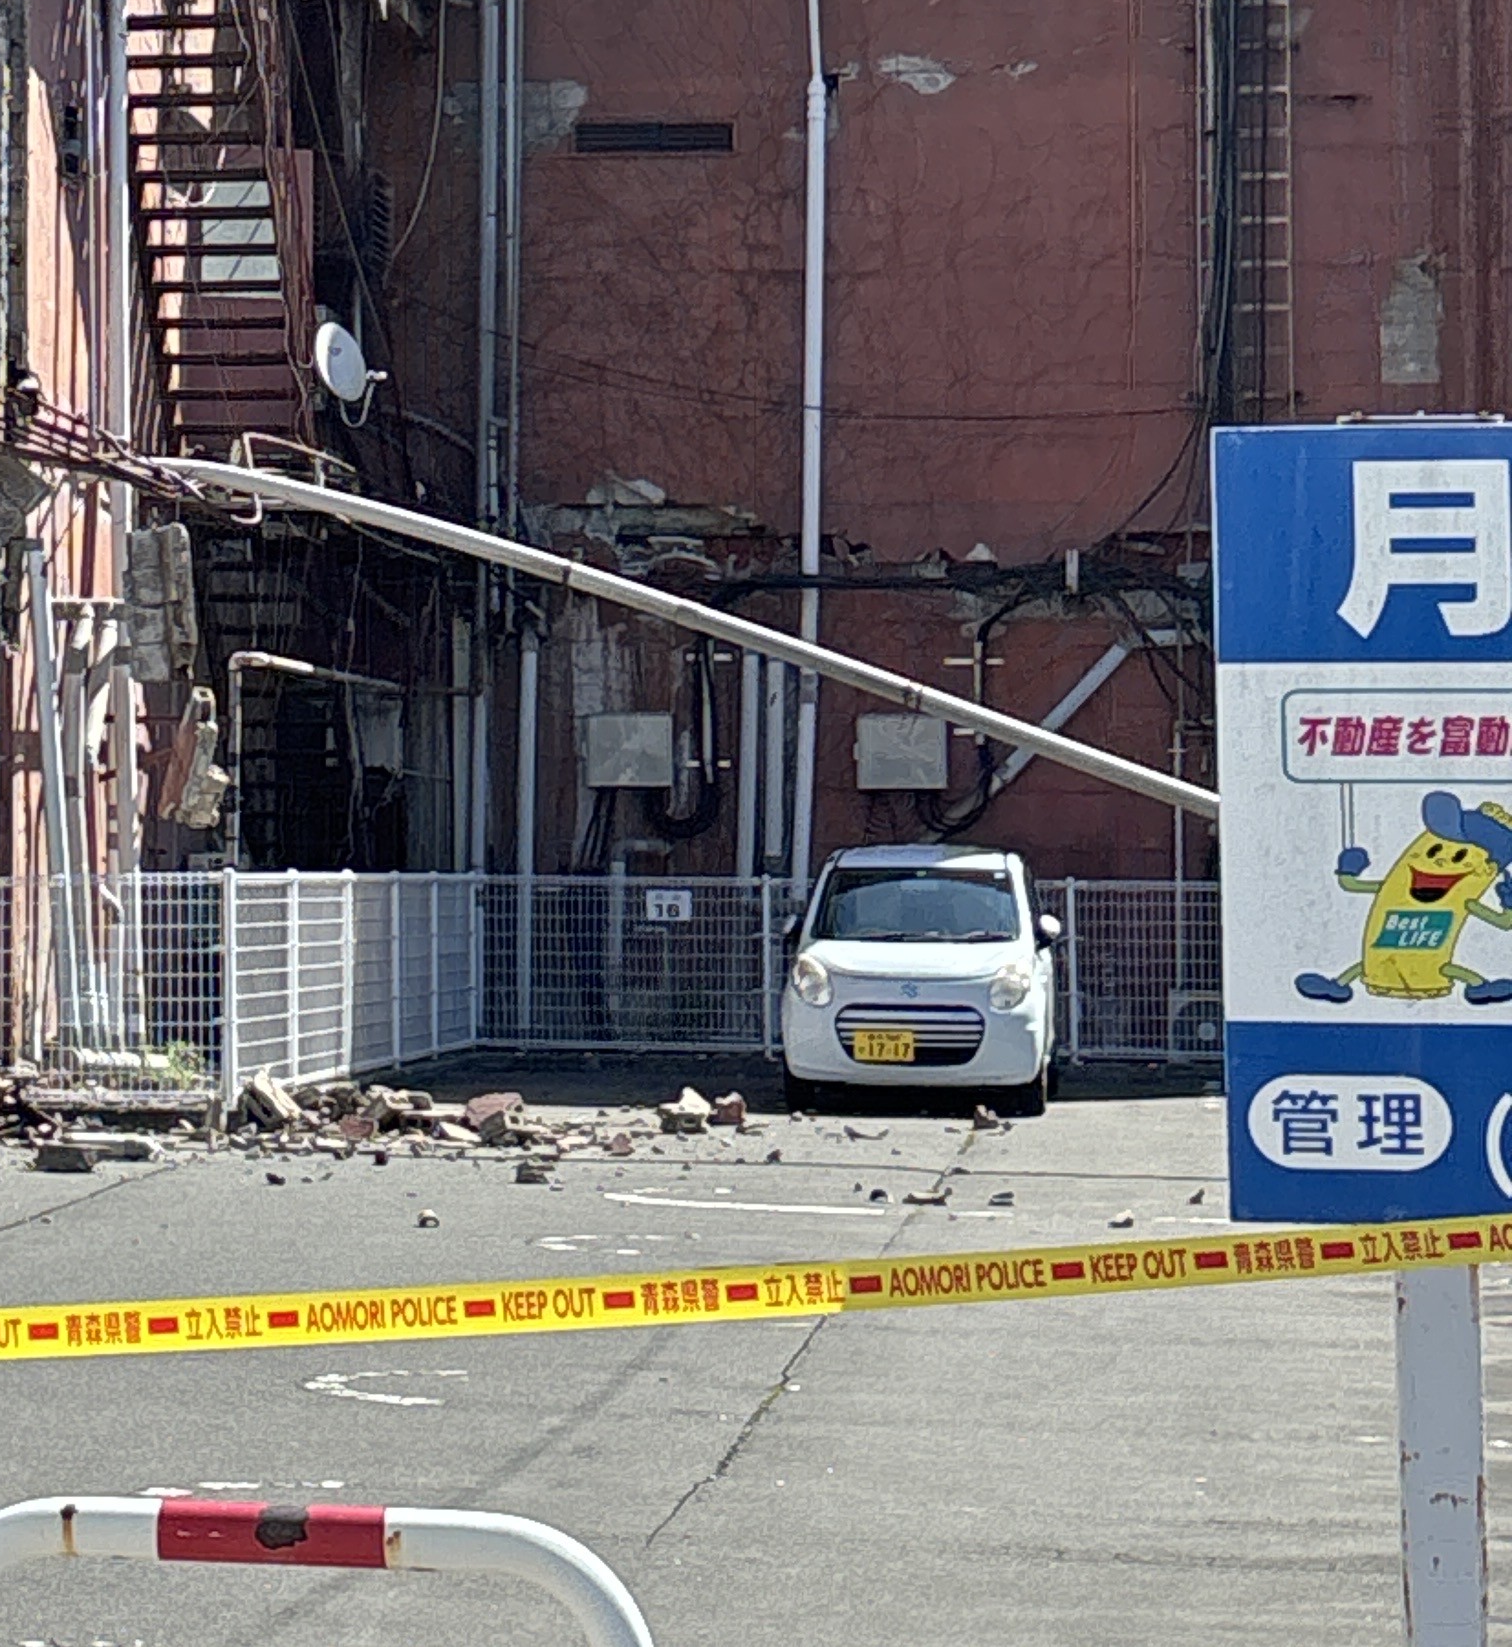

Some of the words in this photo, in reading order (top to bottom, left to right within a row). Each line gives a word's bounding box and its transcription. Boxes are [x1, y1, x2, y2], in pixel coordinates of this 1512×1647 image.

[1336, 459, 1510, 640] 月
[1298, 715, 1512, 757] 不動産を富動
[1386, 914, 1429, 931] Best
[1398, 930, 1444, 947] LIFE
[1272, 1089, 1425, 1157] 管理
[1362, 1231, 1443, 1263] 立入禁止
[891, 1265, 970, 1296] AOMORI
[976, 1259, 1046, 1290] POLICE
[1091, 1253, 1137, 1282] KEEP
[1144, 1249, 1186, 1278] OUT
[503, 1291, 547, 1320] KEEP
[554, 1288, 595, 1316] OUT
[766, 1273, 844, 1305] 立入禁止
[186, 1306, 260, 1339] 立入禁止
[308, 1300, 385, 1331] AOMORI
[391, 1296, 456, 1326] POLICE
